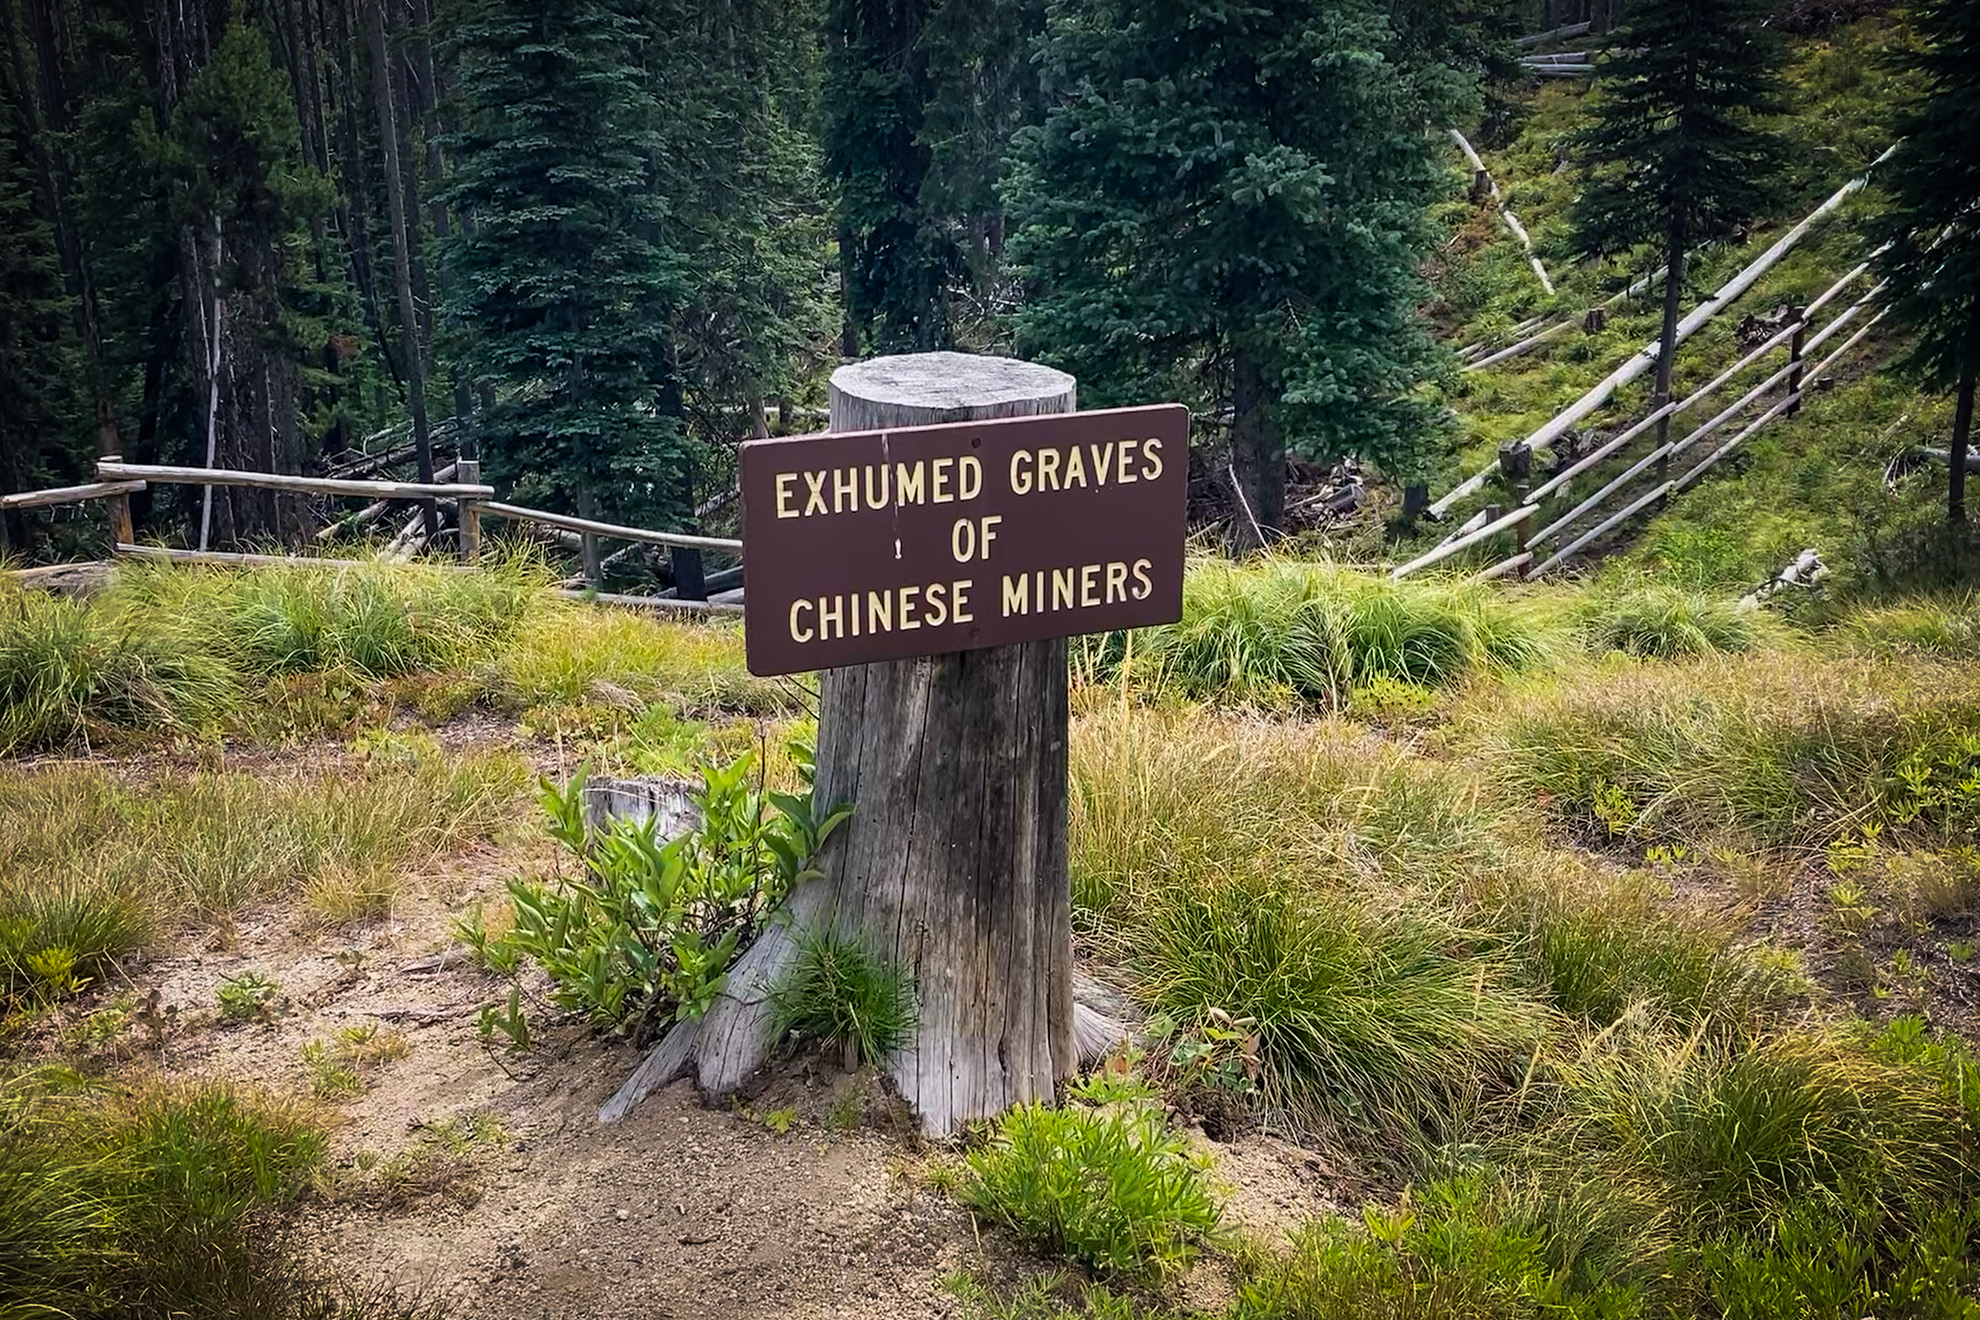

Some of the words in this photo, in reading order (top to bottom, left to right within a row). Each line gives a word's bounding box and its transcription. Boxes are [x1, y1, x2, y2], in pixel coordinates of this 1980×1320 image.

[775, 455, 983, 519] EXHUMED
[1010, 438, 1164, 496] GRAVES
[951, 515, 1002, 563] OF
[789, 579, 974, 643] CHINESE
[1002, 558, 1153, 618] MINERS
